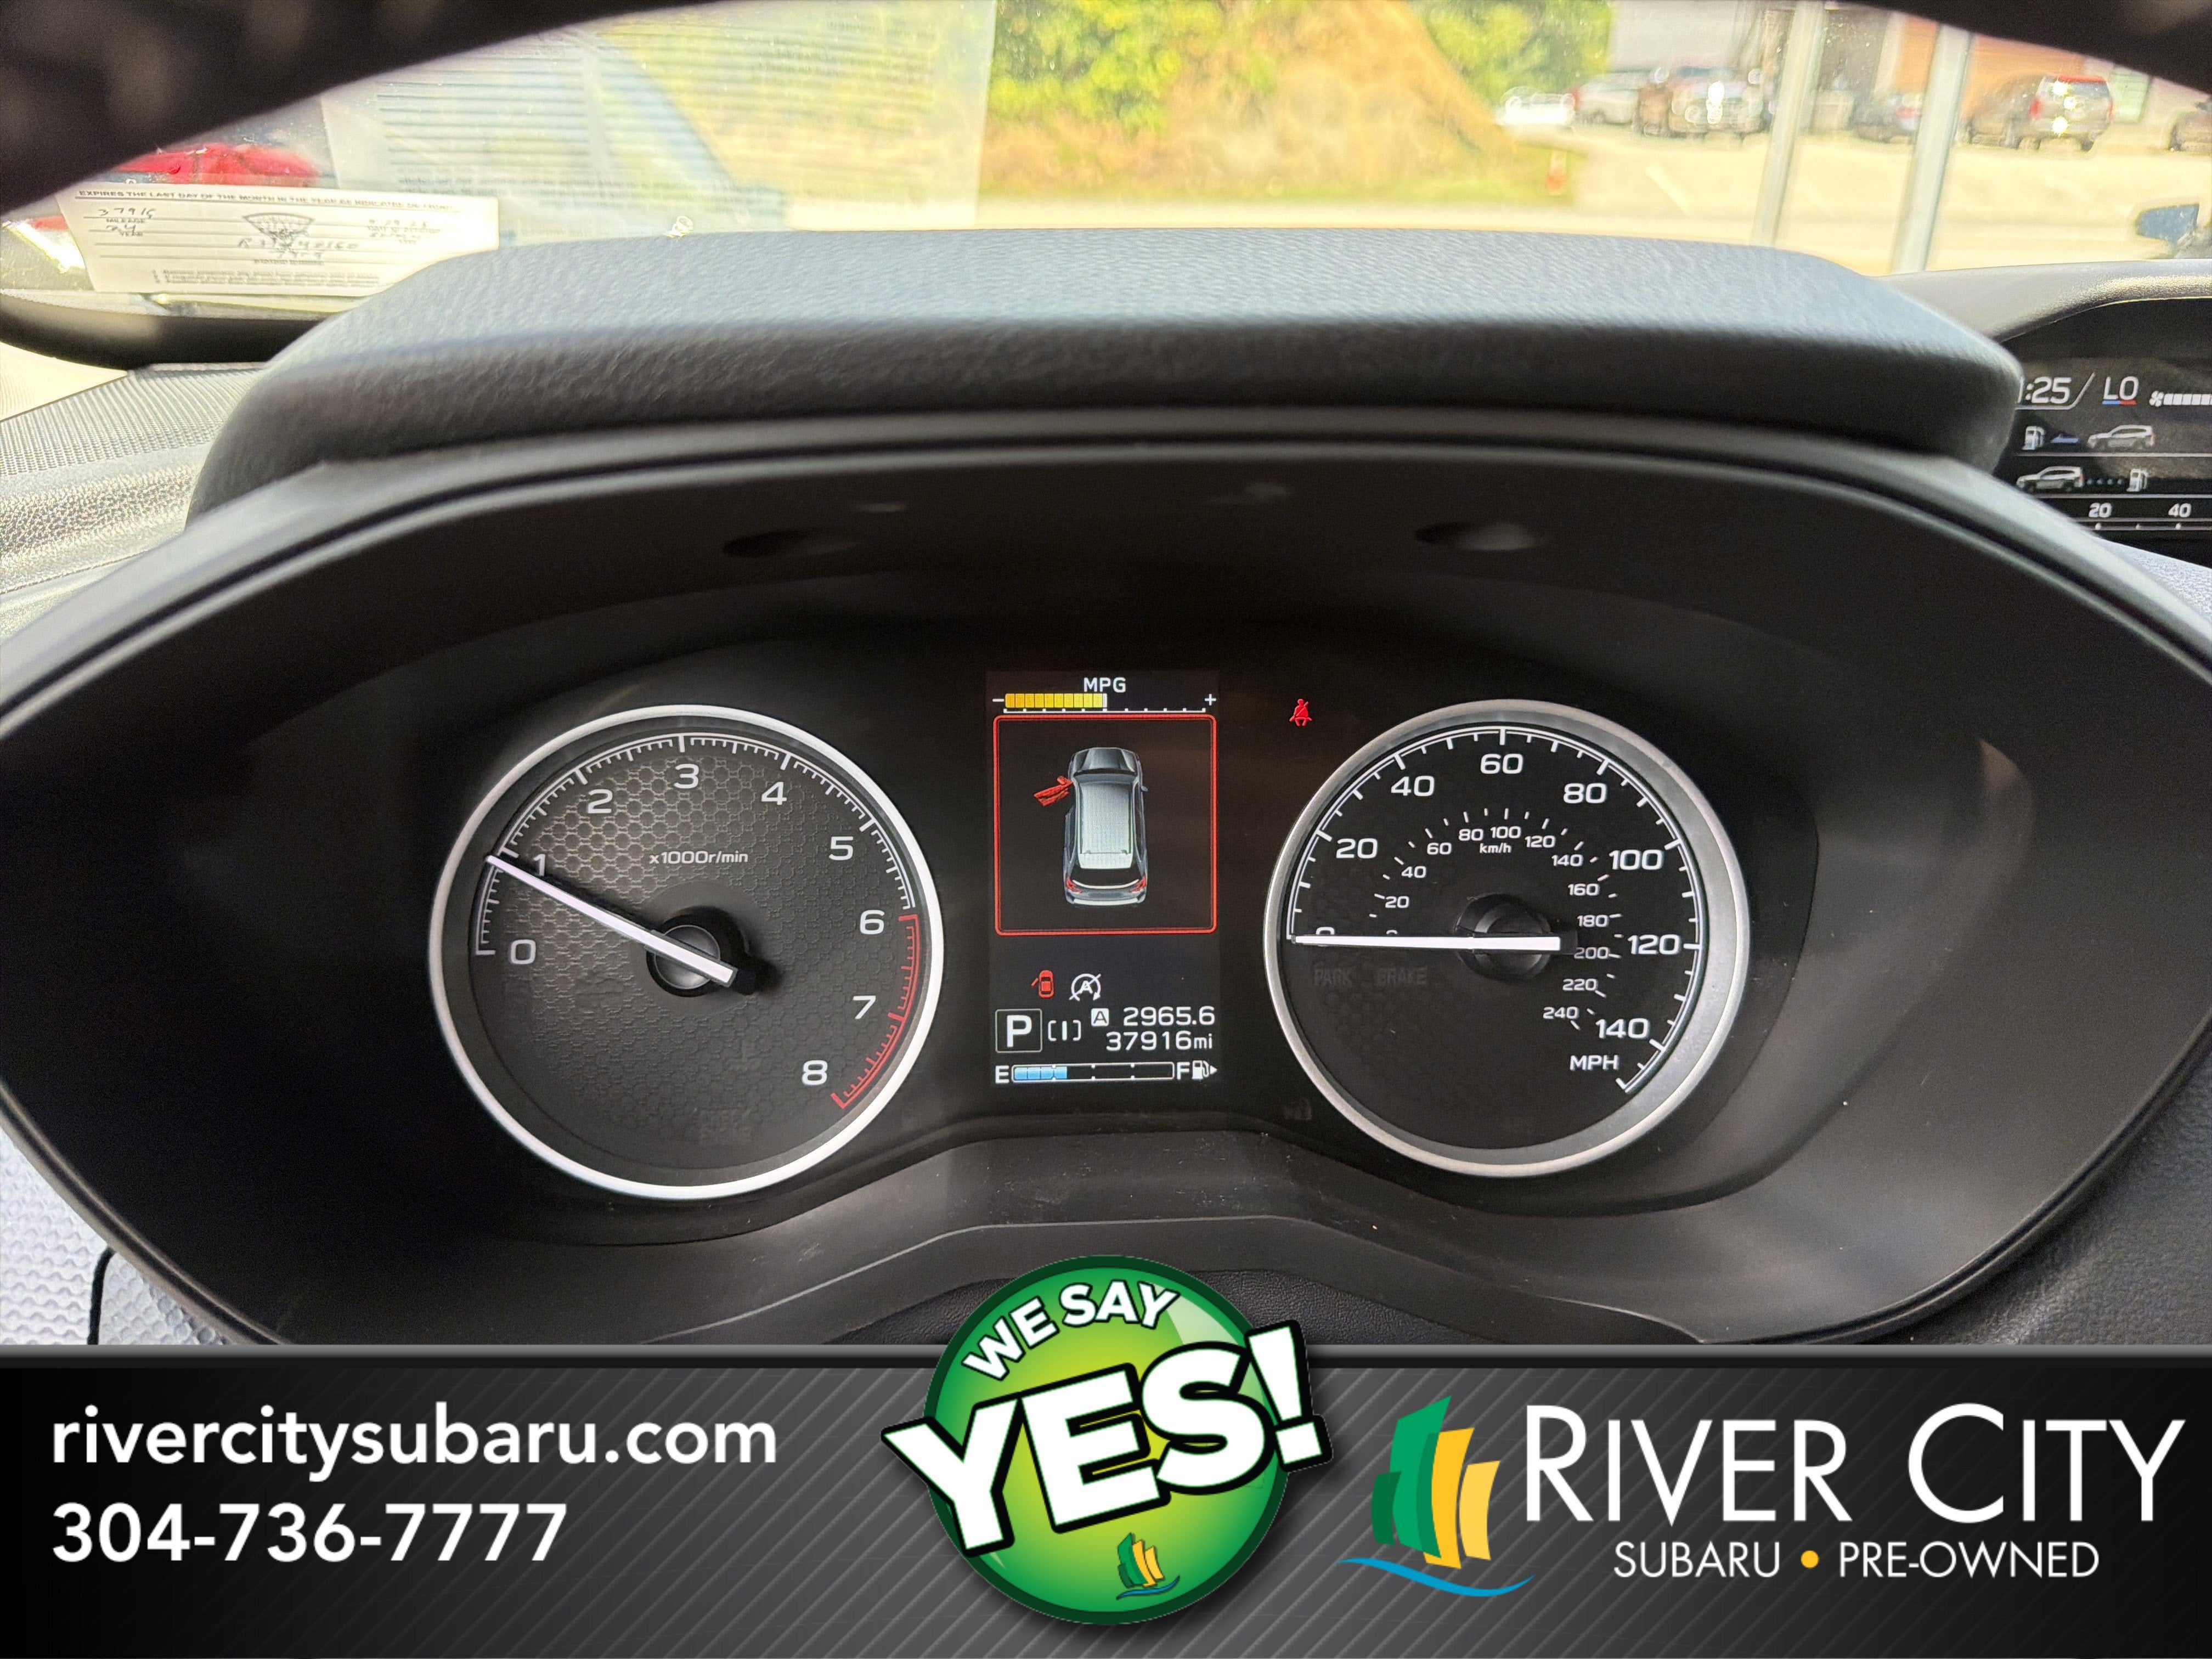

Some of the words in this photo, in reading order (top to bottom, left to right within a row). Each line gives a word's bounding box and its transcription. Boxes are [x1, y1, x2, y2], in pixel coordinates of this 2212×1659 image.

[2103, 376, 2139, 400] LO
[2089, 502, 2112, 518] 20
[2168, 503, 2192, 517] 40
[1084, 677, 1126, 693] MPG
[1480, 753, 1523, 774] 60
[674, 763, 699, 789] 3
[1391, 775, 1435, 797] 40
[588, 789, 613, 814] 2
[761, 781, 787, 805] 4
[1563, 782, 1607, 804] 80
[1458, 828, 1484, 842] 80
[1490, 826, 1522, 839] 100
[1525, 835, 1556, 848] 120
[649, 850, 748, 865] x1000r/min
[828, 836, 854, 861] 5
[1336, 838, 1378, 859] 20
[1426, 842, 1452, 855] 60
[1479, 842, 1512, 854] km/h
[533, 854, 546, 877] 1
[1551, 854, 1584, 867] 140
[1609, 849, 1664, 870] 100
[1401, 866, 1427, 879] 40
[1567, 883, 1600, 896] 160
[1385, 895, 1410, 909] 20
[860, 910, 885, 935] 6
[1577, 915, 1609, 928] 180
[510, 939, 537, 965] 0
[1573, 946, 1609, 960] 200
[1627, 934, 1680, 955] 120
[1562, 978, 1598, 991] 220
[853, 995, 876, 1020] 7
[1543, 1006, 1579, 1019] 240
[1007, 1014, 1032, 1048] P
[1123, 1006, 1215, 1026] 2965.6
[1595, 1018, 1650, 1039] 140
[801, 1059, 828, 1086] 8
[995, 1065, 1010, 1084] E
[1177, 1062, 1190, 1080] F
[1570, 1054, 1619, 1071] MPH
